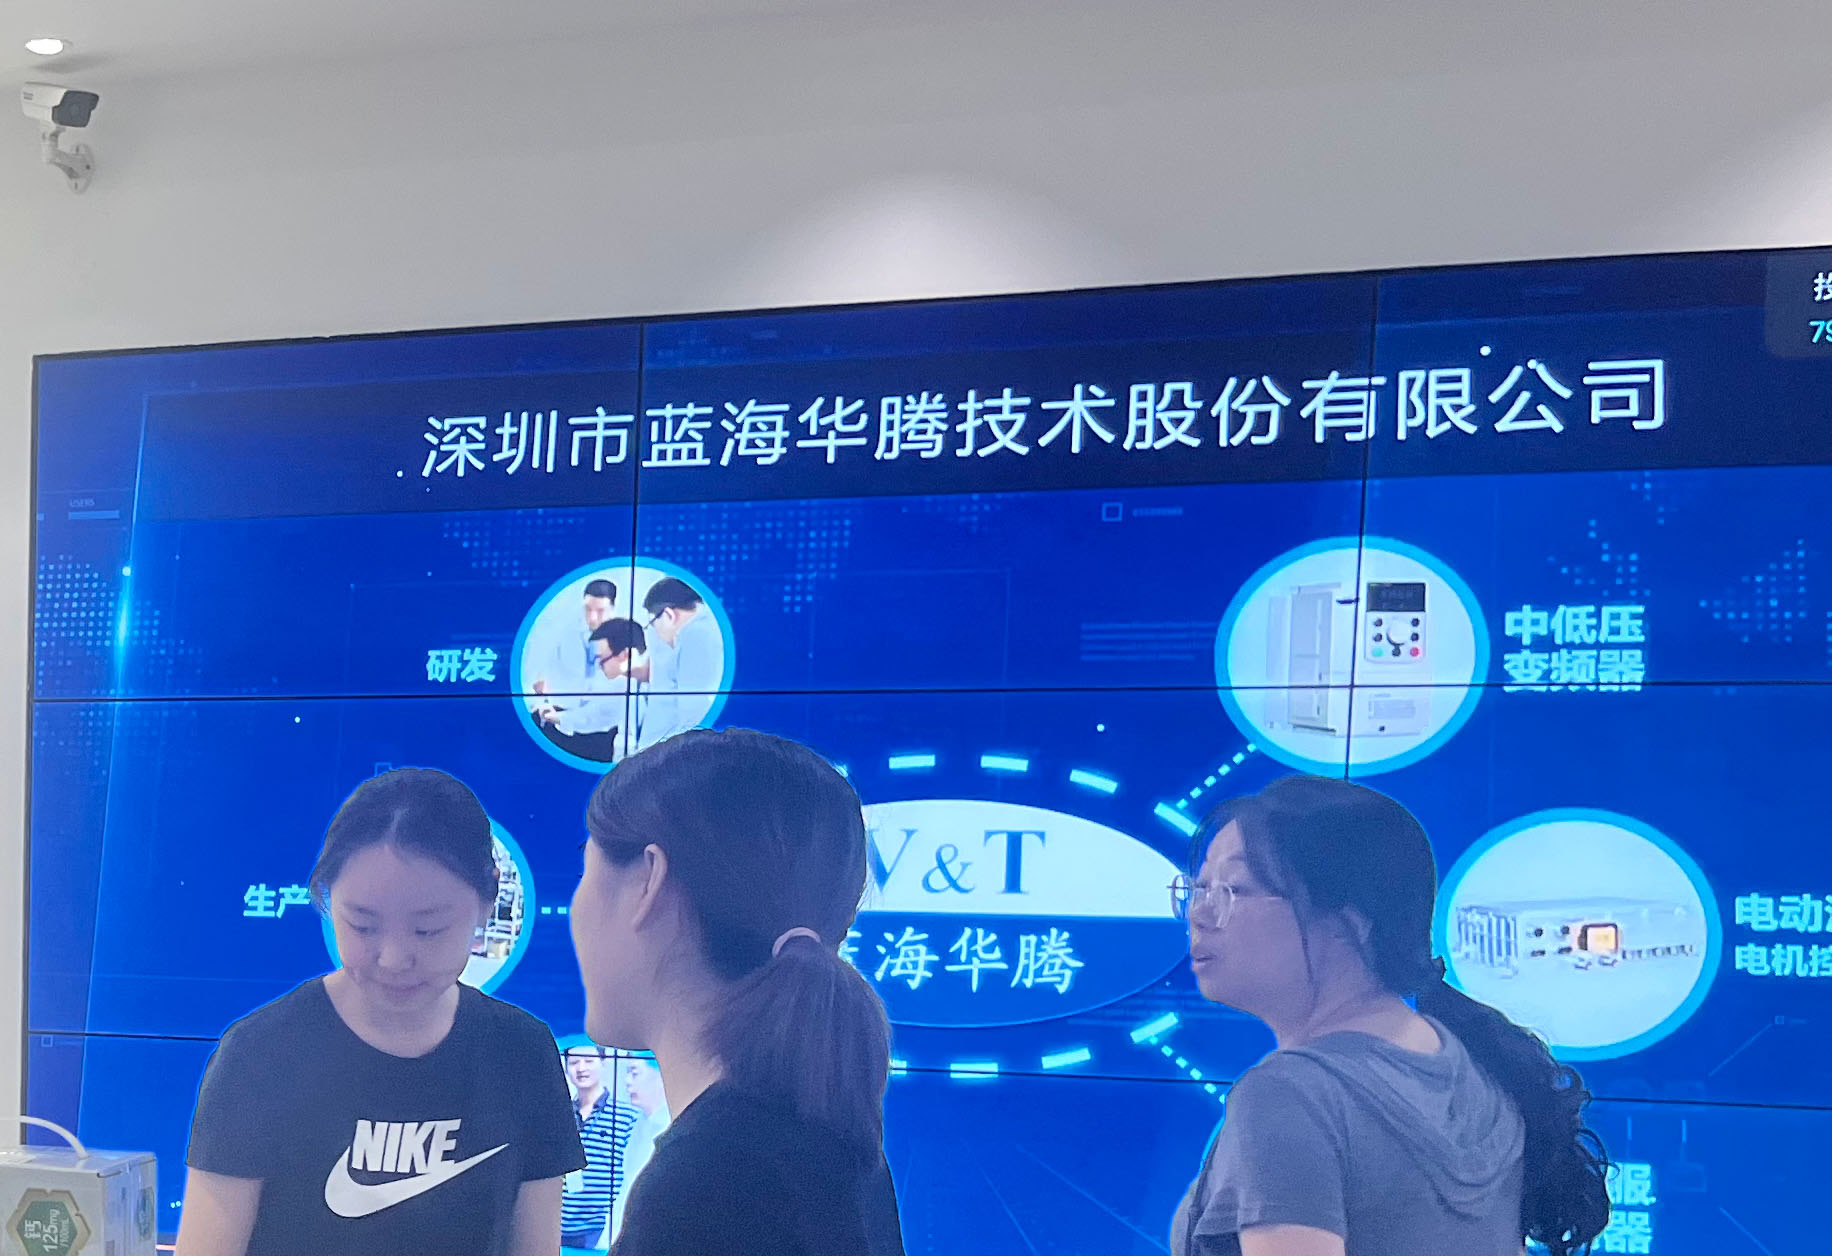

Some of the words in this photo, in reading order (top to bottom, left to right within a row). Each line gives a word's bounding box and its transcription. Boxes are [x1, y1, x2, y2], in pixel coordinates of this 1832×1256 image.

[422, 358, 1666, 478] 深圳市蓝海华腾技术股份有限公司
[1503, 604, 1645, 646] 中低压
[425, 647, 498, 683] 研发
[1503, 648, 1645, 692] 变频器
[865, 829, 1046, 895] V&T
[243, 883, 311, 918] 生产
[839, 926, 1085, 995] 海华腾
[352, 1119, 462, 1174] NIKE
[23, 1219, 42, 1241] 钙
